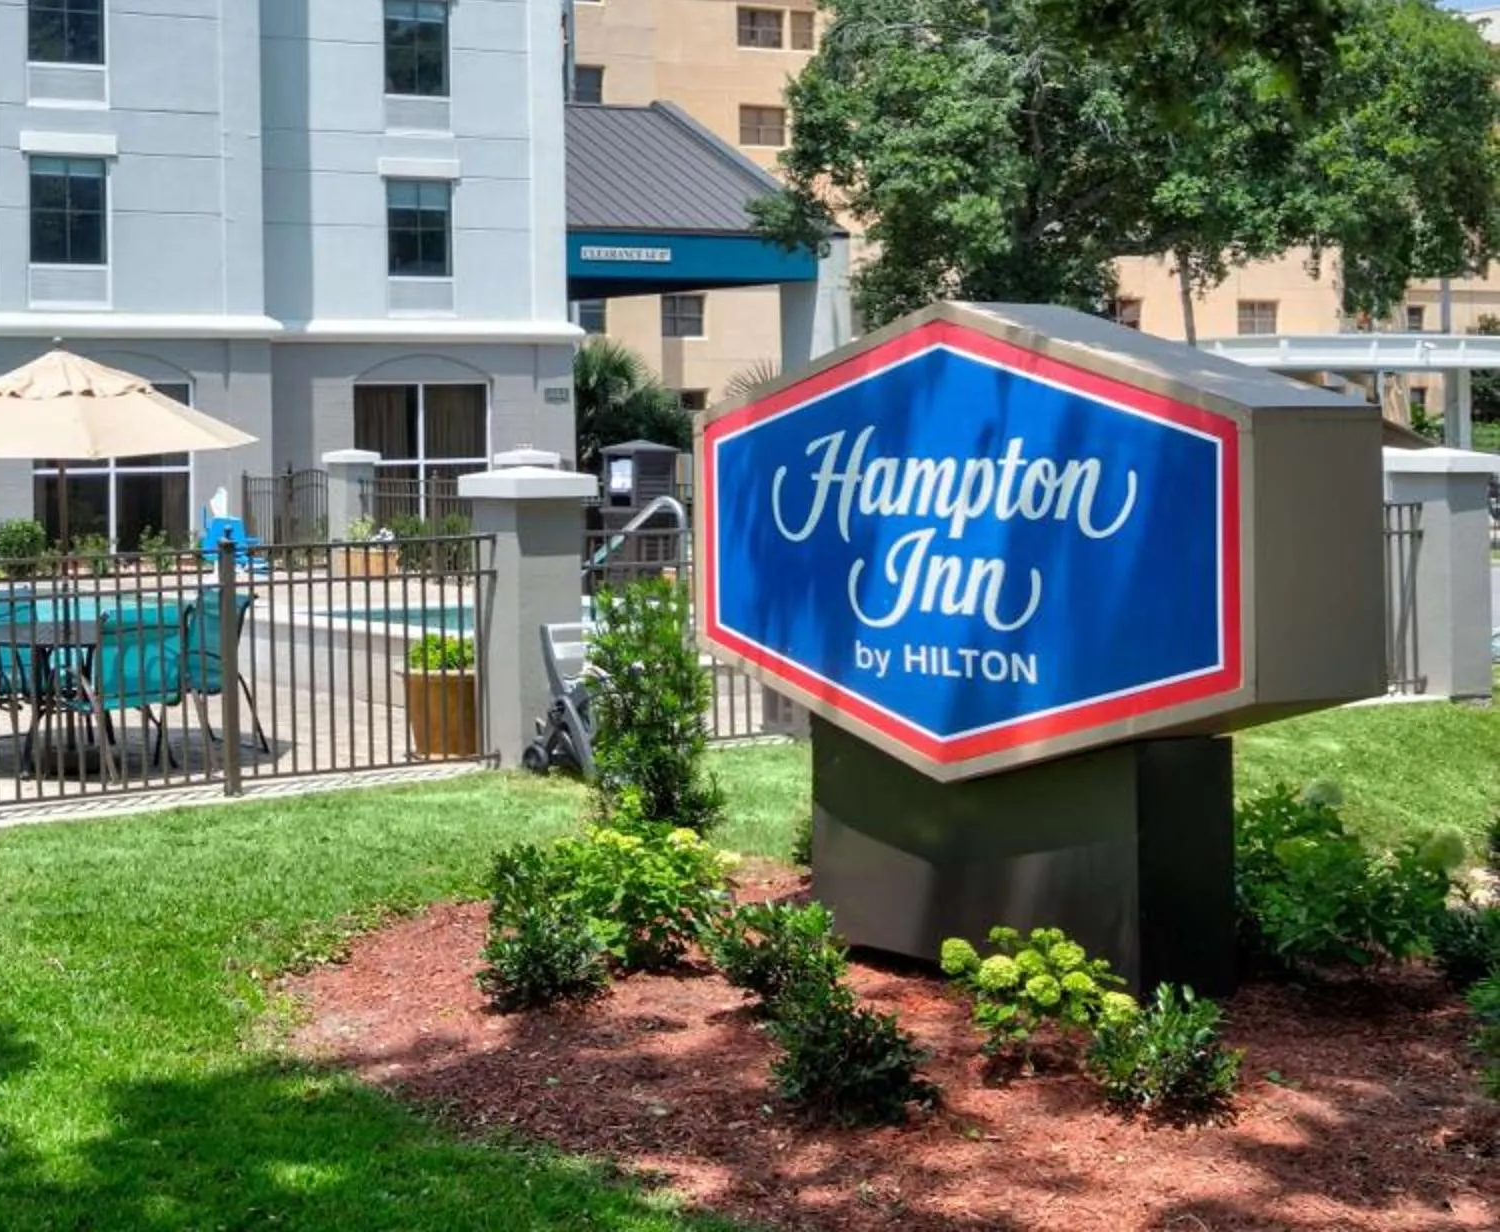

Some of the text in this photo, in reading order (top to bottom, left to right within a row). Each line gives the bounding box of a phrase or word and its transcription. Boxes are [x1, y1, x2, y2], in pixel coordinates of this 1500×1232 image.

[771, 425, 1137, 544] Hampton
[848, 527, 1041, 631] Inn
[855, 639, 1038, 685] by HILTON
